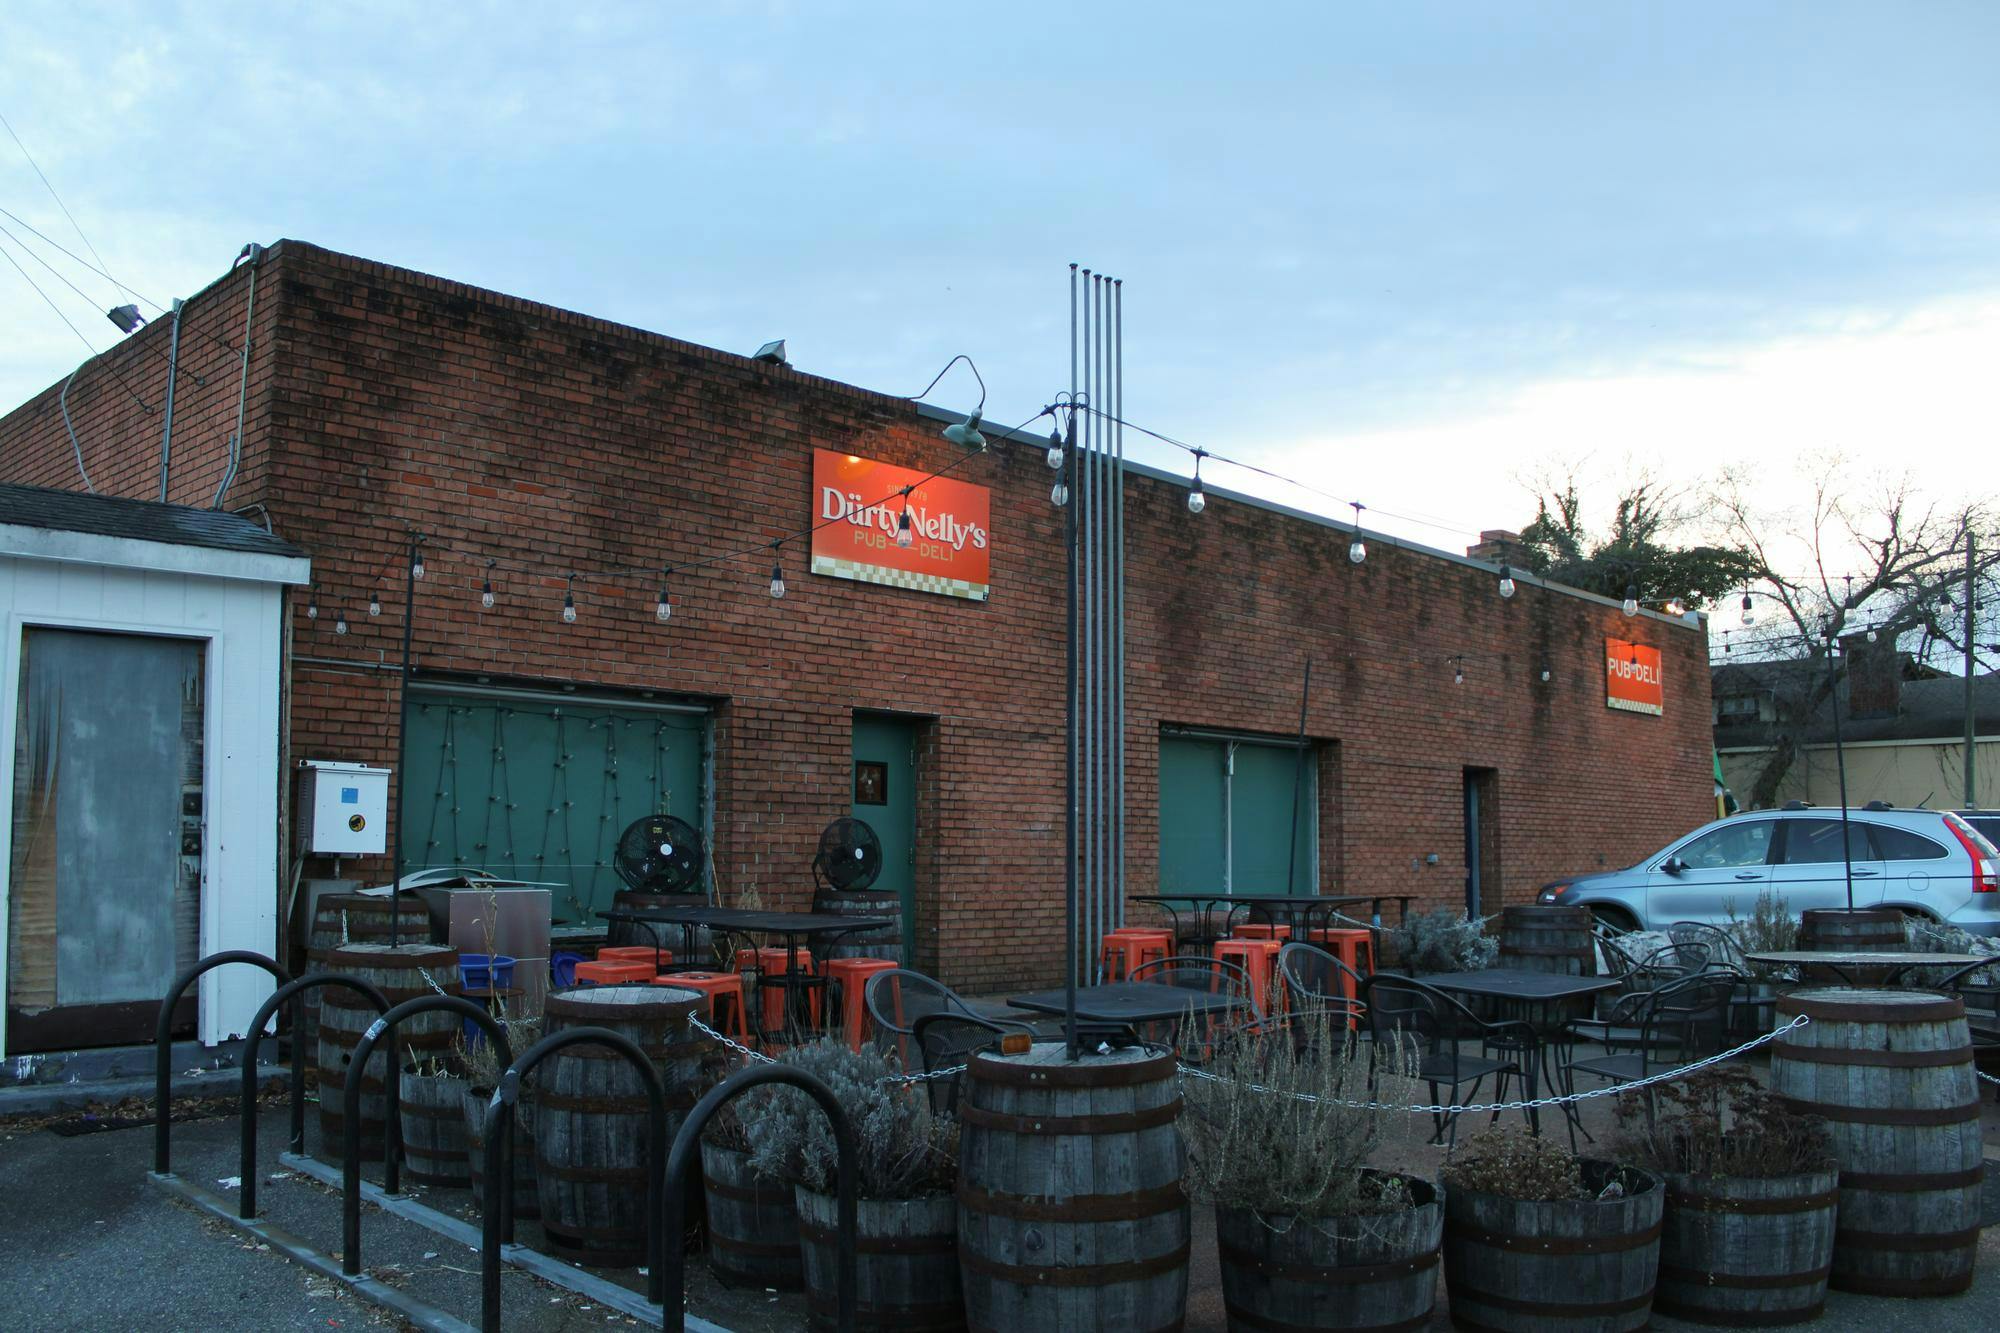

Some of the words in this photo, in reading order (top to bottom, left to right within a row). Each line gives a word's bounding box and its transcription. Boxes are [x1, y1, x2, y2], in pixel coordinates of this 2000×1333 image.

[822, 486, 903, 538] Dürty
[905, 504, 986, 551] Nelly's
[854, 530, 887, 550] PUB
[920, 543, 954, 562] DELI
[1608, 657, 1631, 679] PUB
[1635, 663, 1660, 685] DELI
